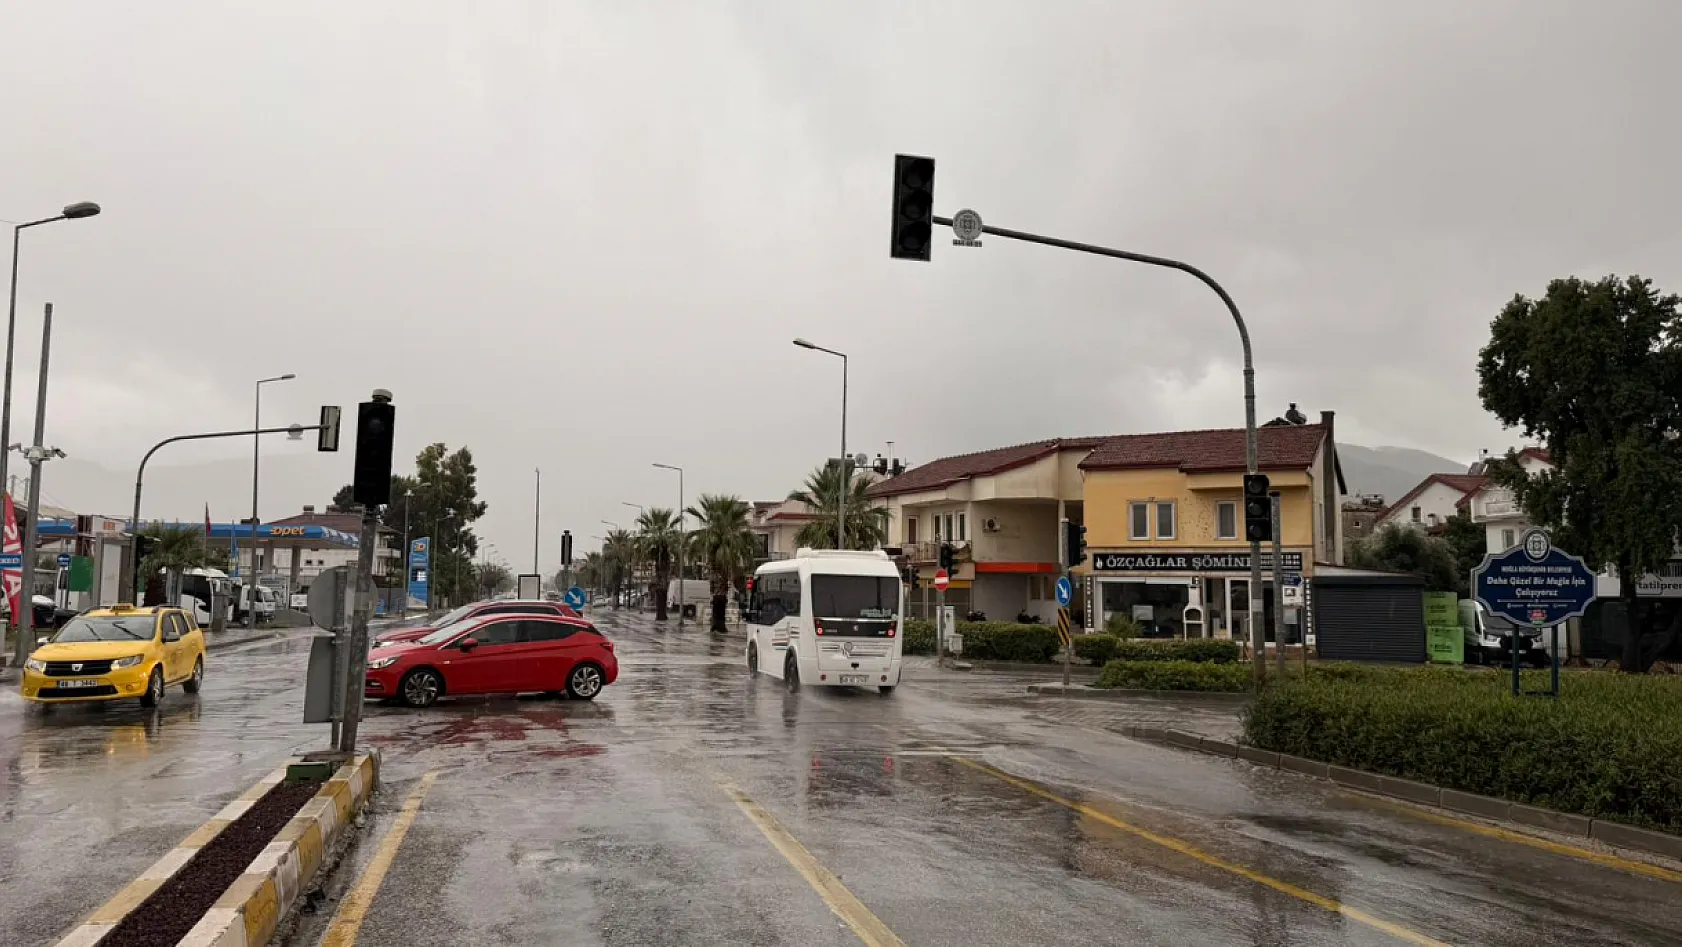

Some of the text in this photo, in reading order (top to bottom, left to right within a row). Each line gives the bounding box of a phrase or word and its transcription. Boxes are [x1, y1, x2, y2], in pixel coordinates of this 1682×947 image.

[1106, 555, 1187, 570] ÖZÇAĞLAR
[1486, 575, 1586, 588] Daha Güzel Bir Muğla İçin
